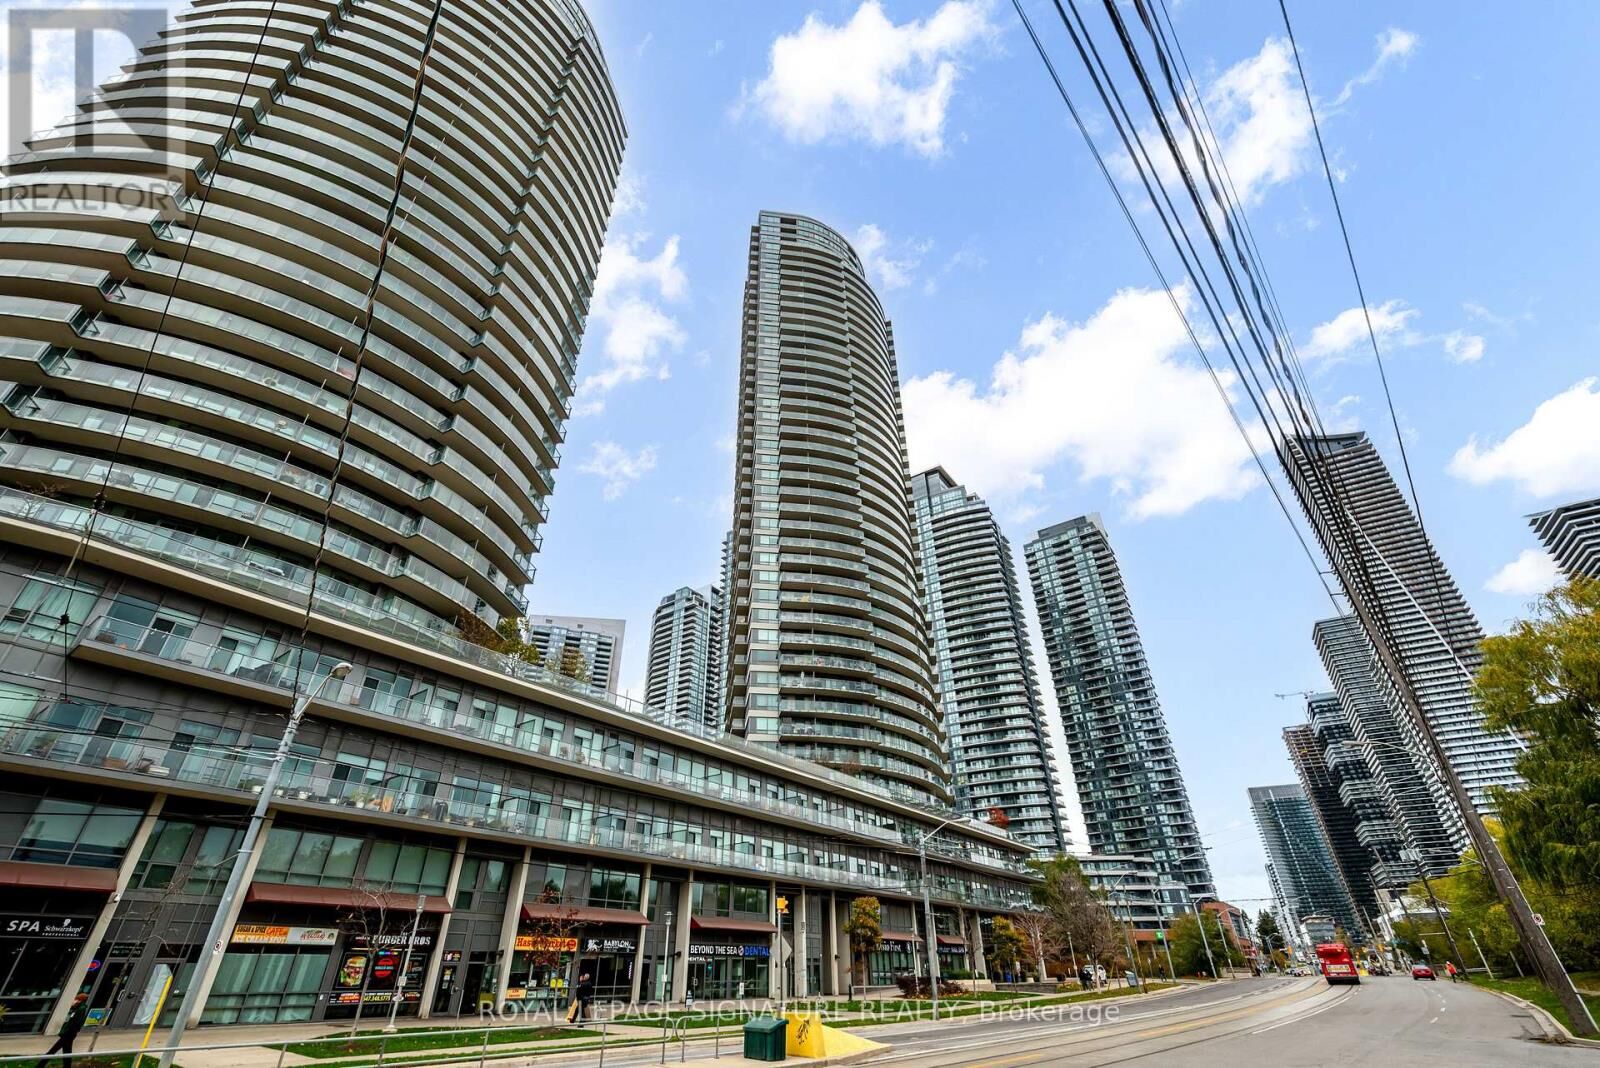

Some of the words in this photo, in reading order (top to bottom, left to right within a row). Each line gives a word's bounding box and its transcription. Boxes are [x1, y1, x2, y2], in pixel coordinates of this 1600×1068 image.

[7, 920, 40, 931] SPA
[44, 925, 83, 933] Schwarzkopf
[603, 939, 629, 948] BABYLON
[690, 944, 715, 955] BEYOND
[715, 946, 726, 955] THE
[726, 946, 738, 955] SEA
[744, 947, 770, 956] DENTAL
